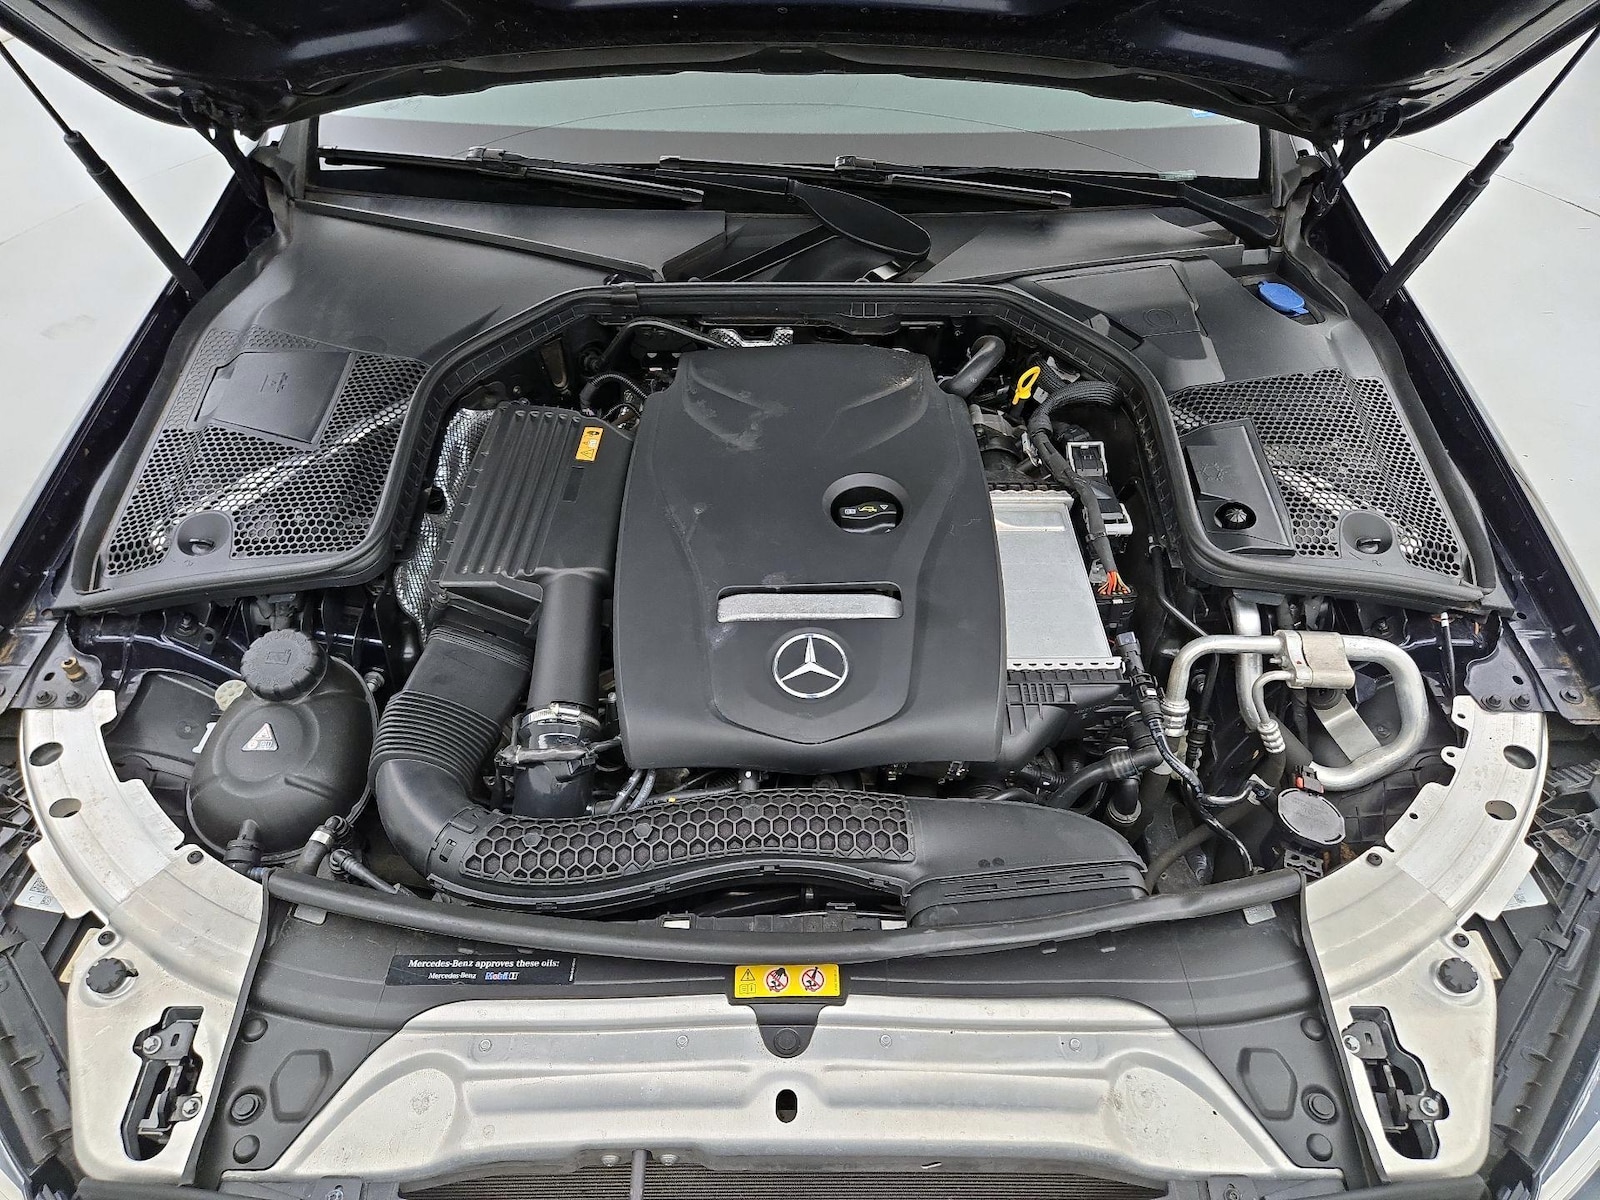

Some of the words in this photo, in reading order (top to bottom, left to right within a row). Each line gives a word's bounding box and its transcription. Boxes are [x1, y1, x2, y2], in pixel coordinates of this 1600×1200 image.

[408, 959, 473, 968] Mercedes-Benz
[475, 959, 514, 970] approves
[516, 959, 540, 967] these
[541, 959, 560, 967] oils:
[428, 972, 477, 980] Mercedes-Benz
[485, 972, 509, 980] Mobil
